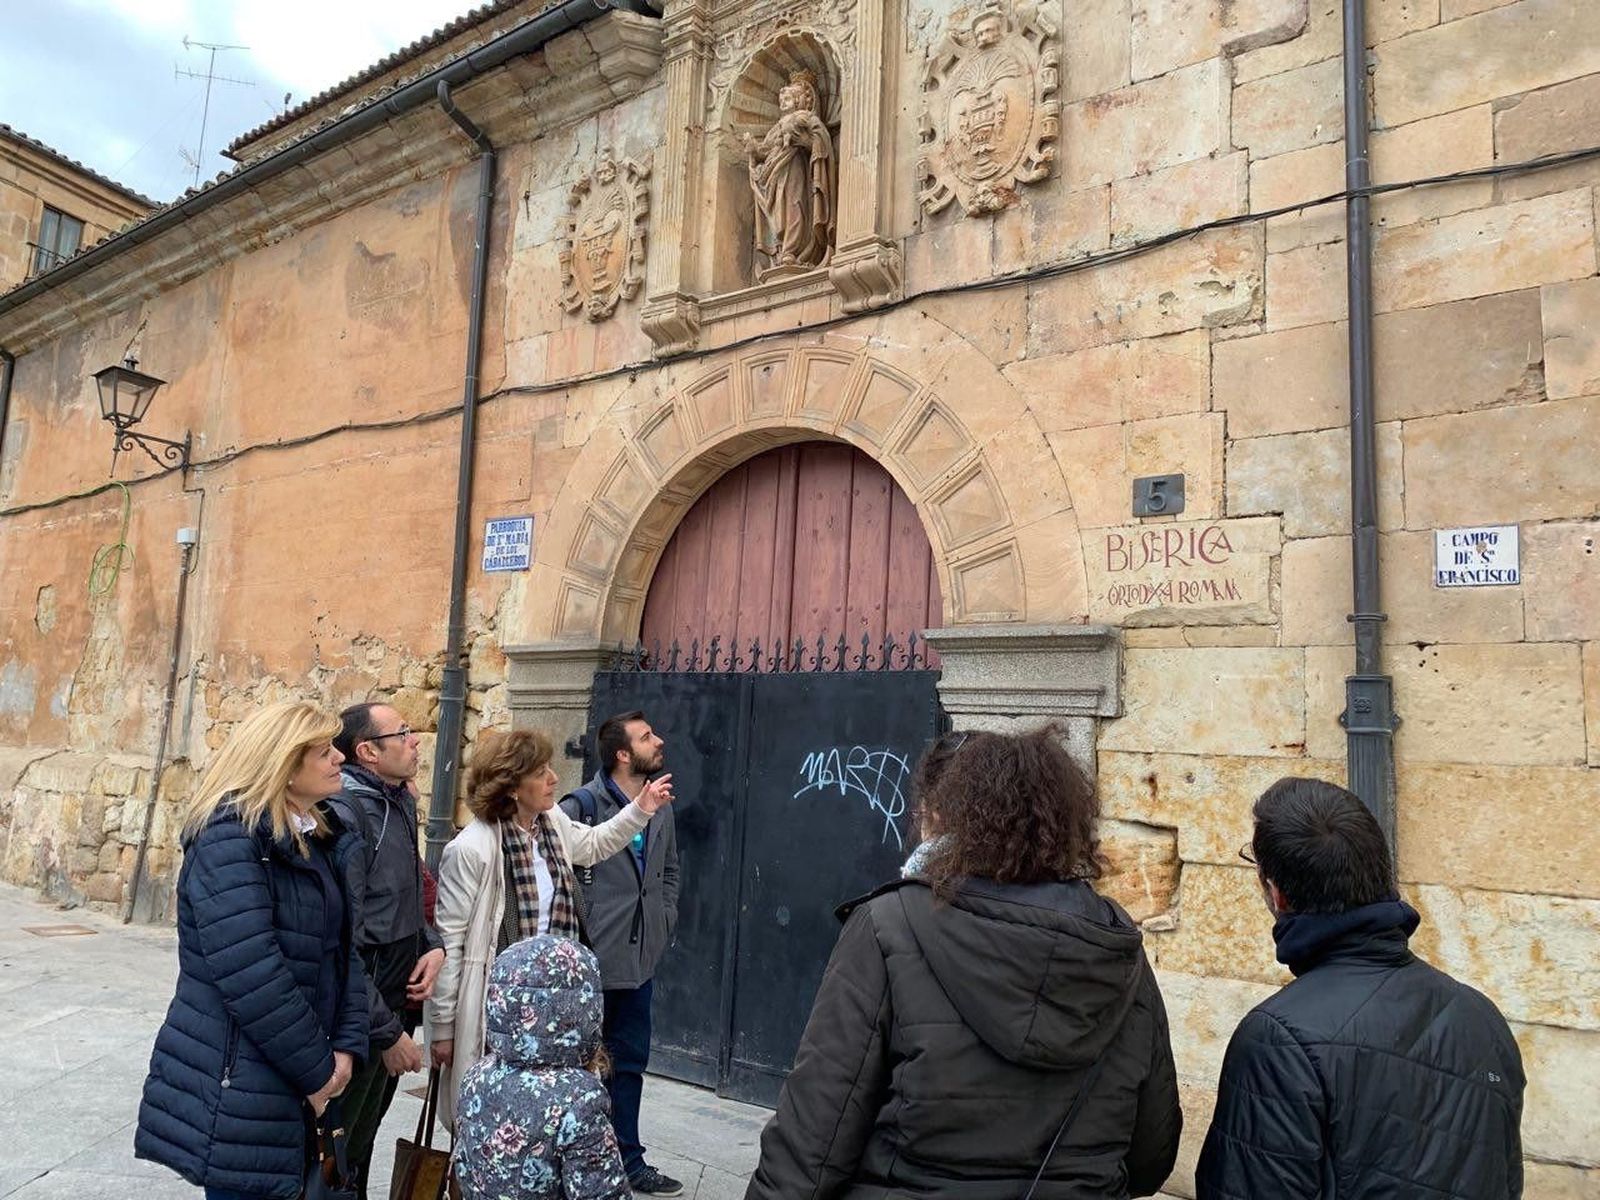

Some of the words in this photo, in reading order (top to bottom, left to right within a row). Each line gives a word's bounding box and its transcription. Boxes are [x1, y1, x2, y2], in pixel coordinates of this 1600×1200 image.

[1150, 480, 1168, 512] 5
[1452, 532, 1499, 547] CAMPO
[1454, 551, 1473, 565] DE
[1439, 569, 1517, 584] FRANCISCO
